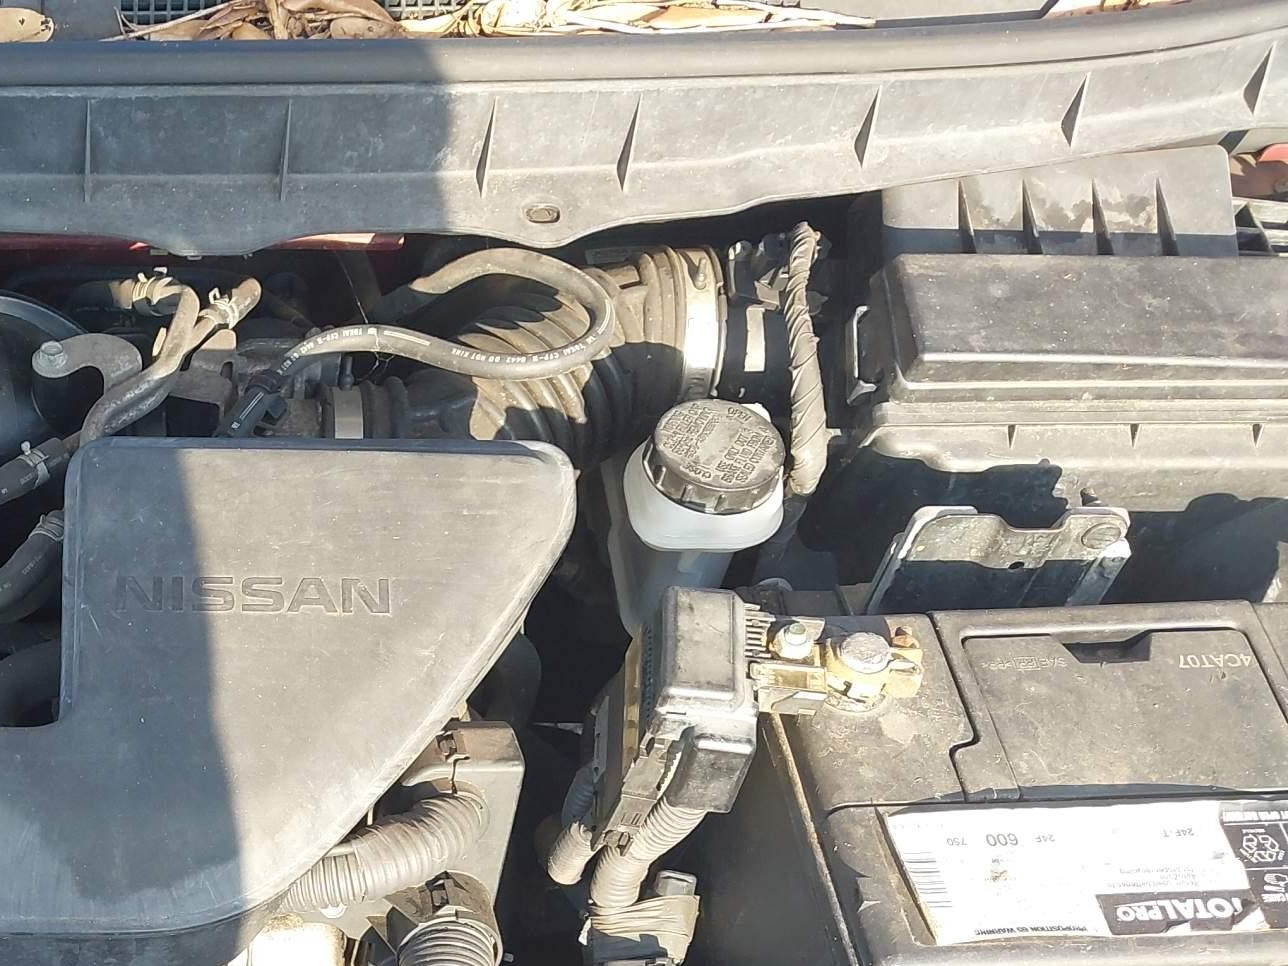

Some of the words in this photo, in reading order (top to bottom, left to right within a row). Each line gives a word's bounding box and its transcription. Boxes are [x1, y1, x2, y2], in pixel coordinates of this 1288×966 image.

[681, 462, 711, 479] CLOSE
[116, 576, 391, 614] NISSAN
[1179, 654, 1253, 670] 4CAT07
[947, 837, 968, 846] 750
[986, 833, 1019, 847] 600
